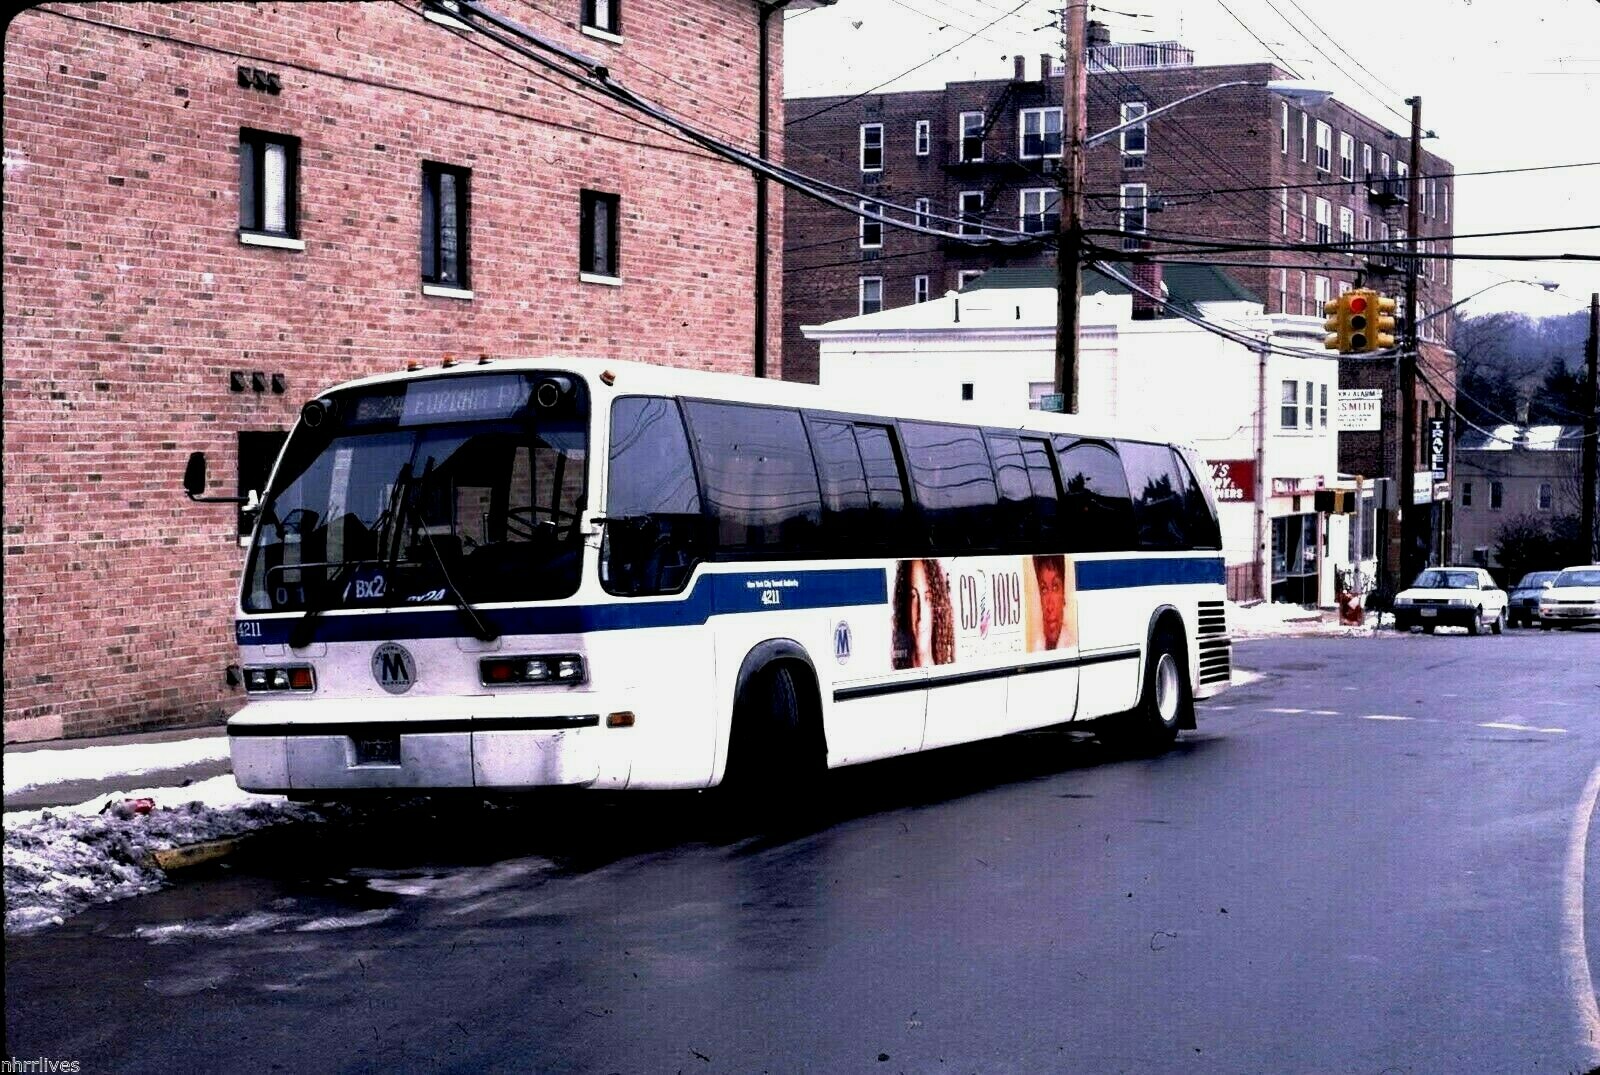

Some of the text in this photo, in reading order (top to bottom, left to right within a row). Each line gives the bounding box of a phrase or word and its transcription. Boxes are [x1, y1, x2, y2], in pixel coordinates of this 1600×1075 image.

[1431, 420, 1445, 471] TRAVEL
[355, 575, 388, 598] BX2
[761, 589, 780, 605] 4211
[959, 571, 1021, 630] CD 101.9
[236, 621, 262, 637] 4211
[382, 653, 409, 680] M
